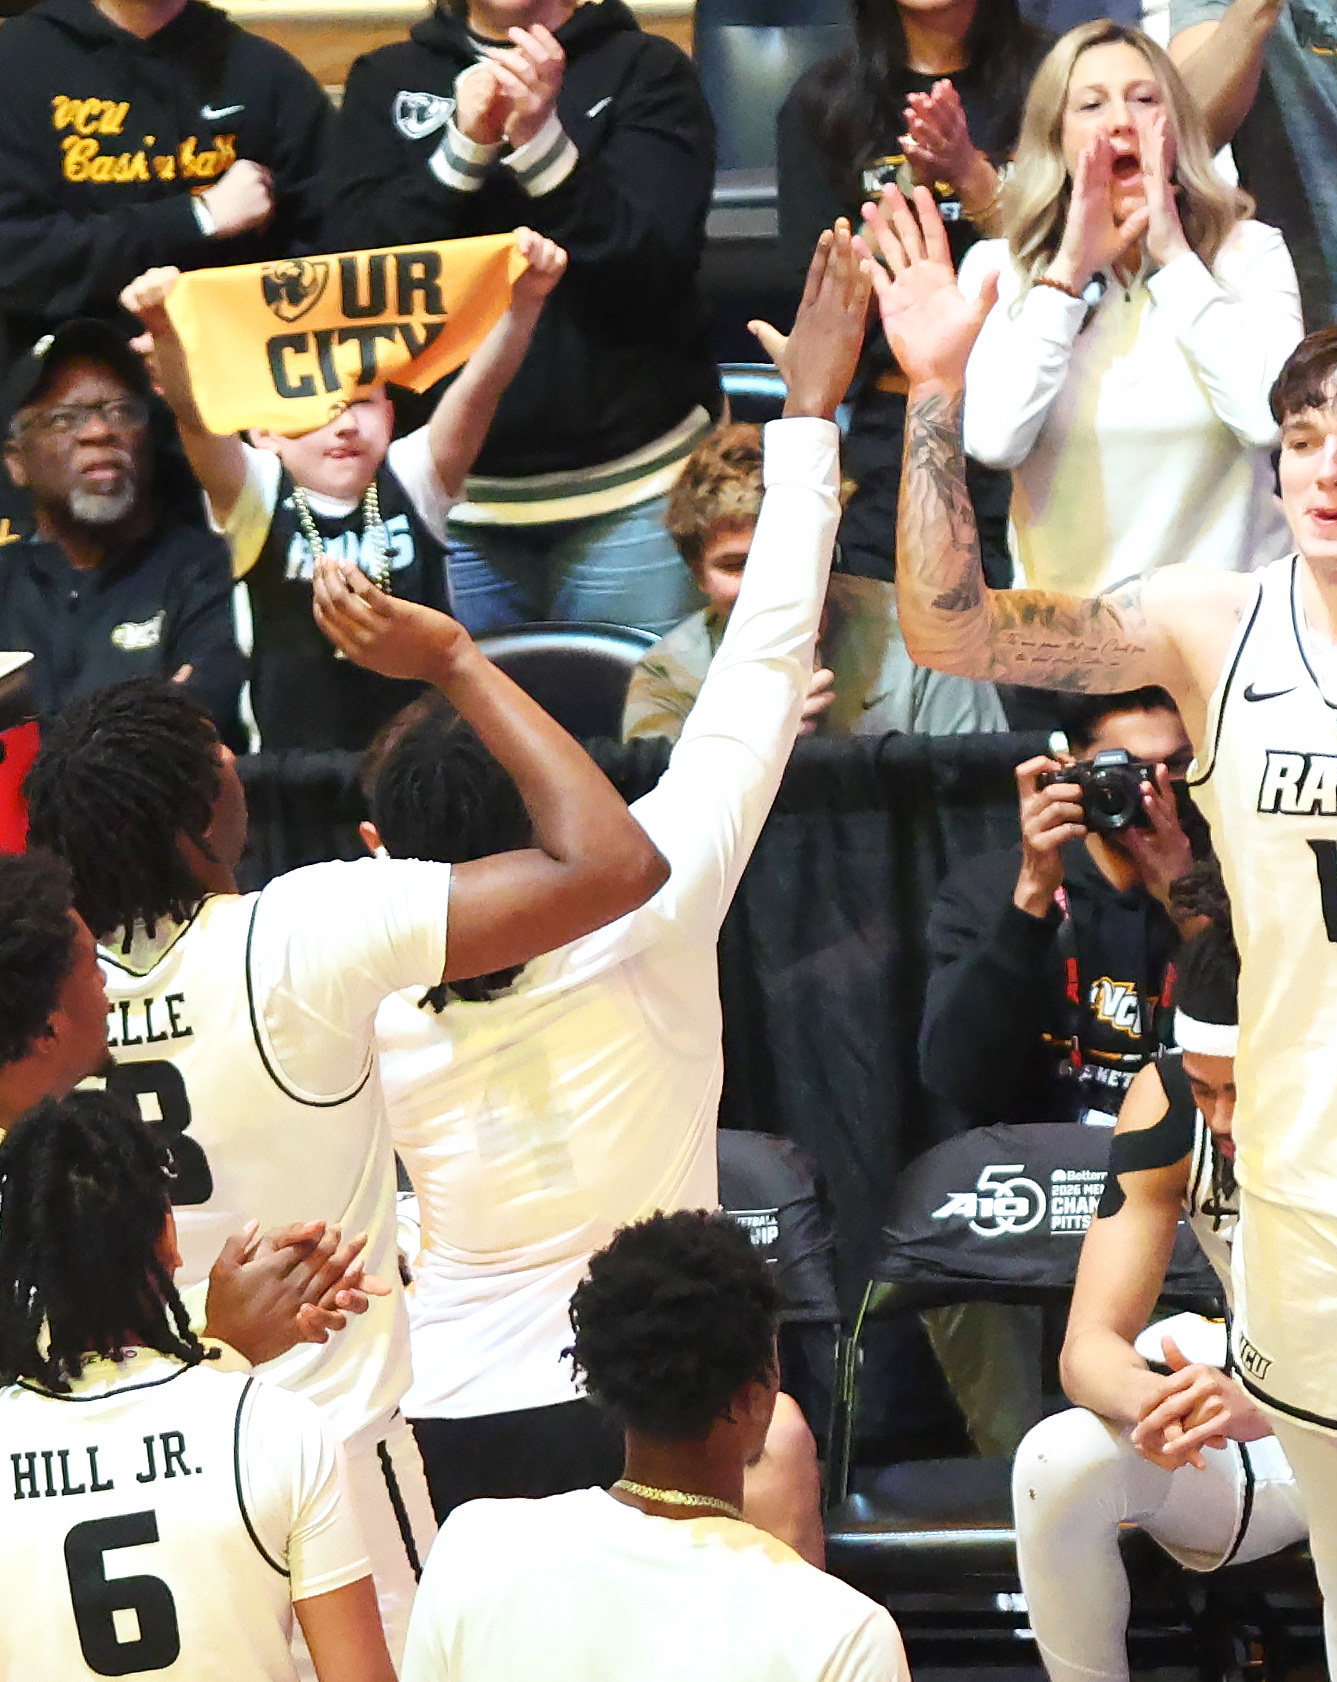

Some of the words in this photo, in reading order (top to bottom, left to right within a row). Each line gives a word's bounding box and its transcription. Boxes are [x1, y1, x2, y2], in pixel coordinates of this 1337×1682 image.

[1052, 1184, 1081, 1196] 2026
[10, 1445, 115, 1500] HILL
[136, 1430, 203, 1483] JR.
[63, 1508, 181, 1677] 6
